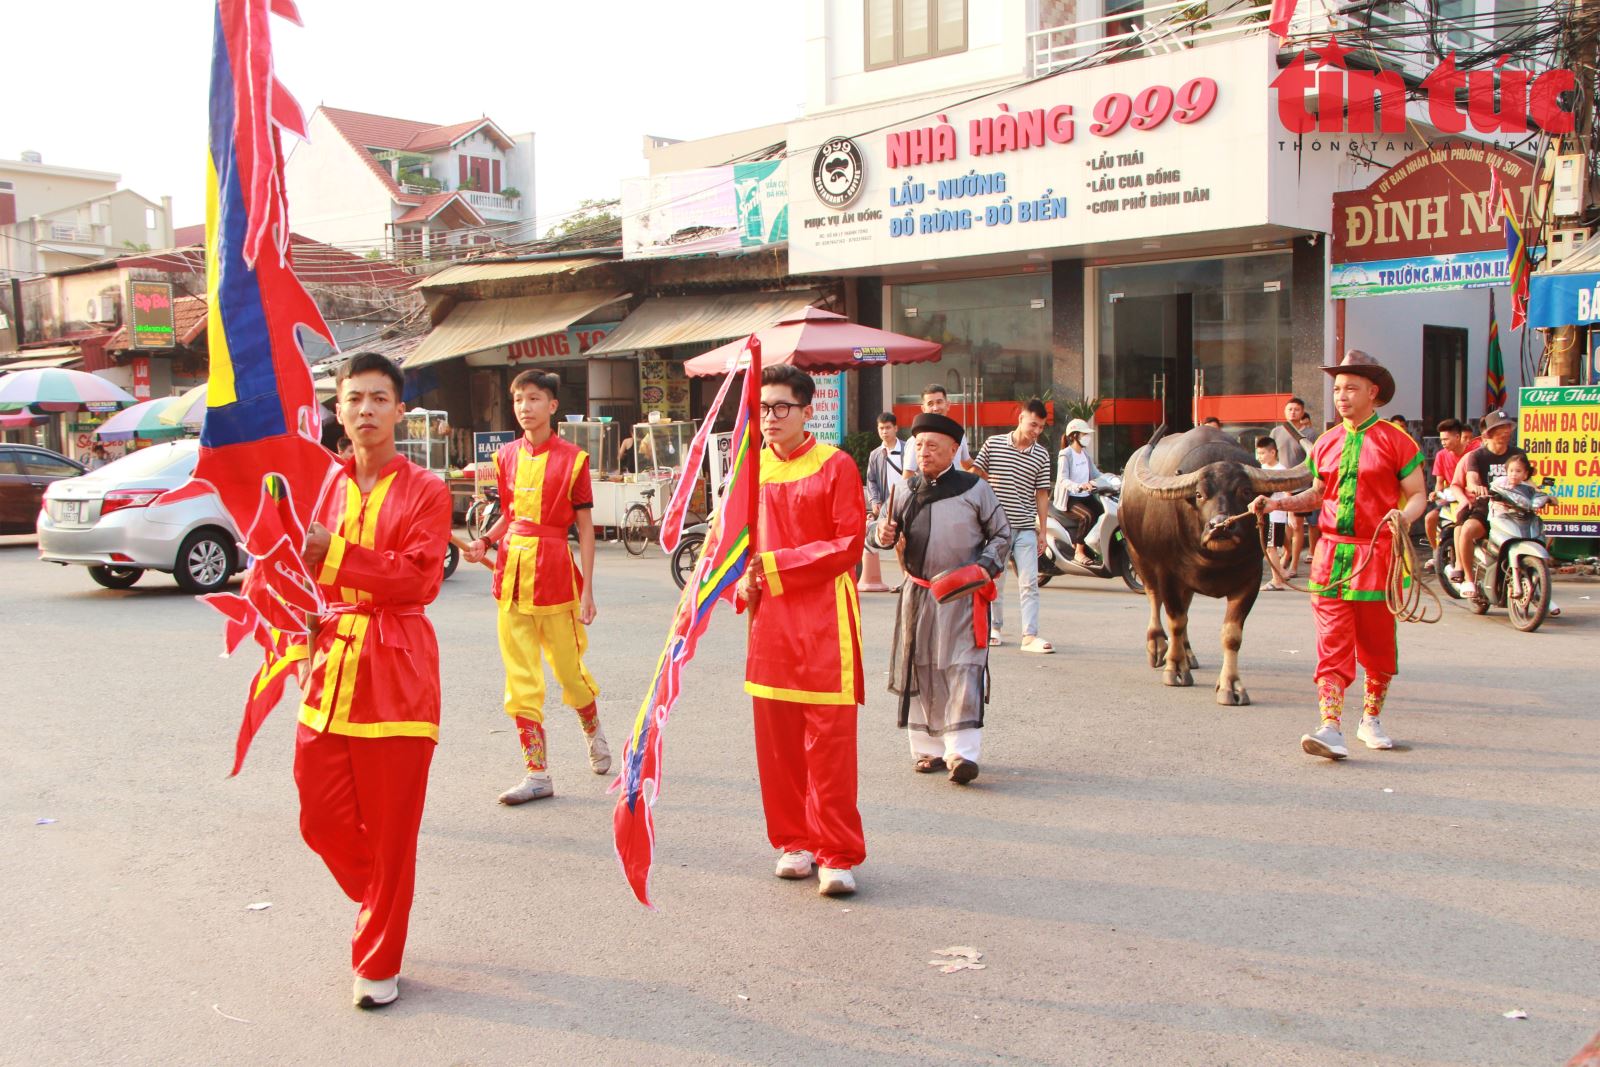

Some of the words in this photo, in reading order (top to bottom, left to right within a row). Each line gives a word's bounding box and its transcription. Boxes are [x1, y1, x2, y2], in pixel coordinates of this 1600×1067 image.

[886, 114, 957, 168] NHÀ
[969, 103, 1075, 156] HÀNG
[1089, 76, 1218, 137] 999
[823, 141, 851, 157] 999
[1091, 150, 1114, 170] LẨU
[1116, 149, 1144, 167] THÁI
[1091, 173, 1115, 192] LẨU
[1118, 175, 1143, 189] CUA
[1389, 167, 1407, 186] BAN
[1502, 160, 1522, 178] SƠN
[889, 175, 924, 207] LẨU
[938, 169, 1006, 201] NƯỚNG
[1092, 200, 1119, 214] CƠM
[1122, 191, 1147, 210] PHỞ
[1150, 191, 1180, 207] BÌNH
[1183, 187, 1210, 203] DÂN
[804, 217, 826, 229] PHỤC
[827, 215, 840, 227] VỤ
[857, 208, 883, 221] UỐNG
[890, 208, 915, 238] ĐỒ
[919, 207, 972, 235] RỪNG
[985, 196, 1012, 226] ĐỒ
[1018, 188, 1067, 223] BIỂN
[1345, 194, 1449, 247] ĐÌNH
[828, 388, 839, 398] ĐA
[1523, 409, 1557, 433] BÁNH
[1560, 412, 1577, 432] ĐA
[1524, 437, 1552, 453] Bánh
[1555, 437, 1569, 453] đa
[1553, 501, 1579, 516] BÌNH
[1564, 524, 1580, 532] 195
